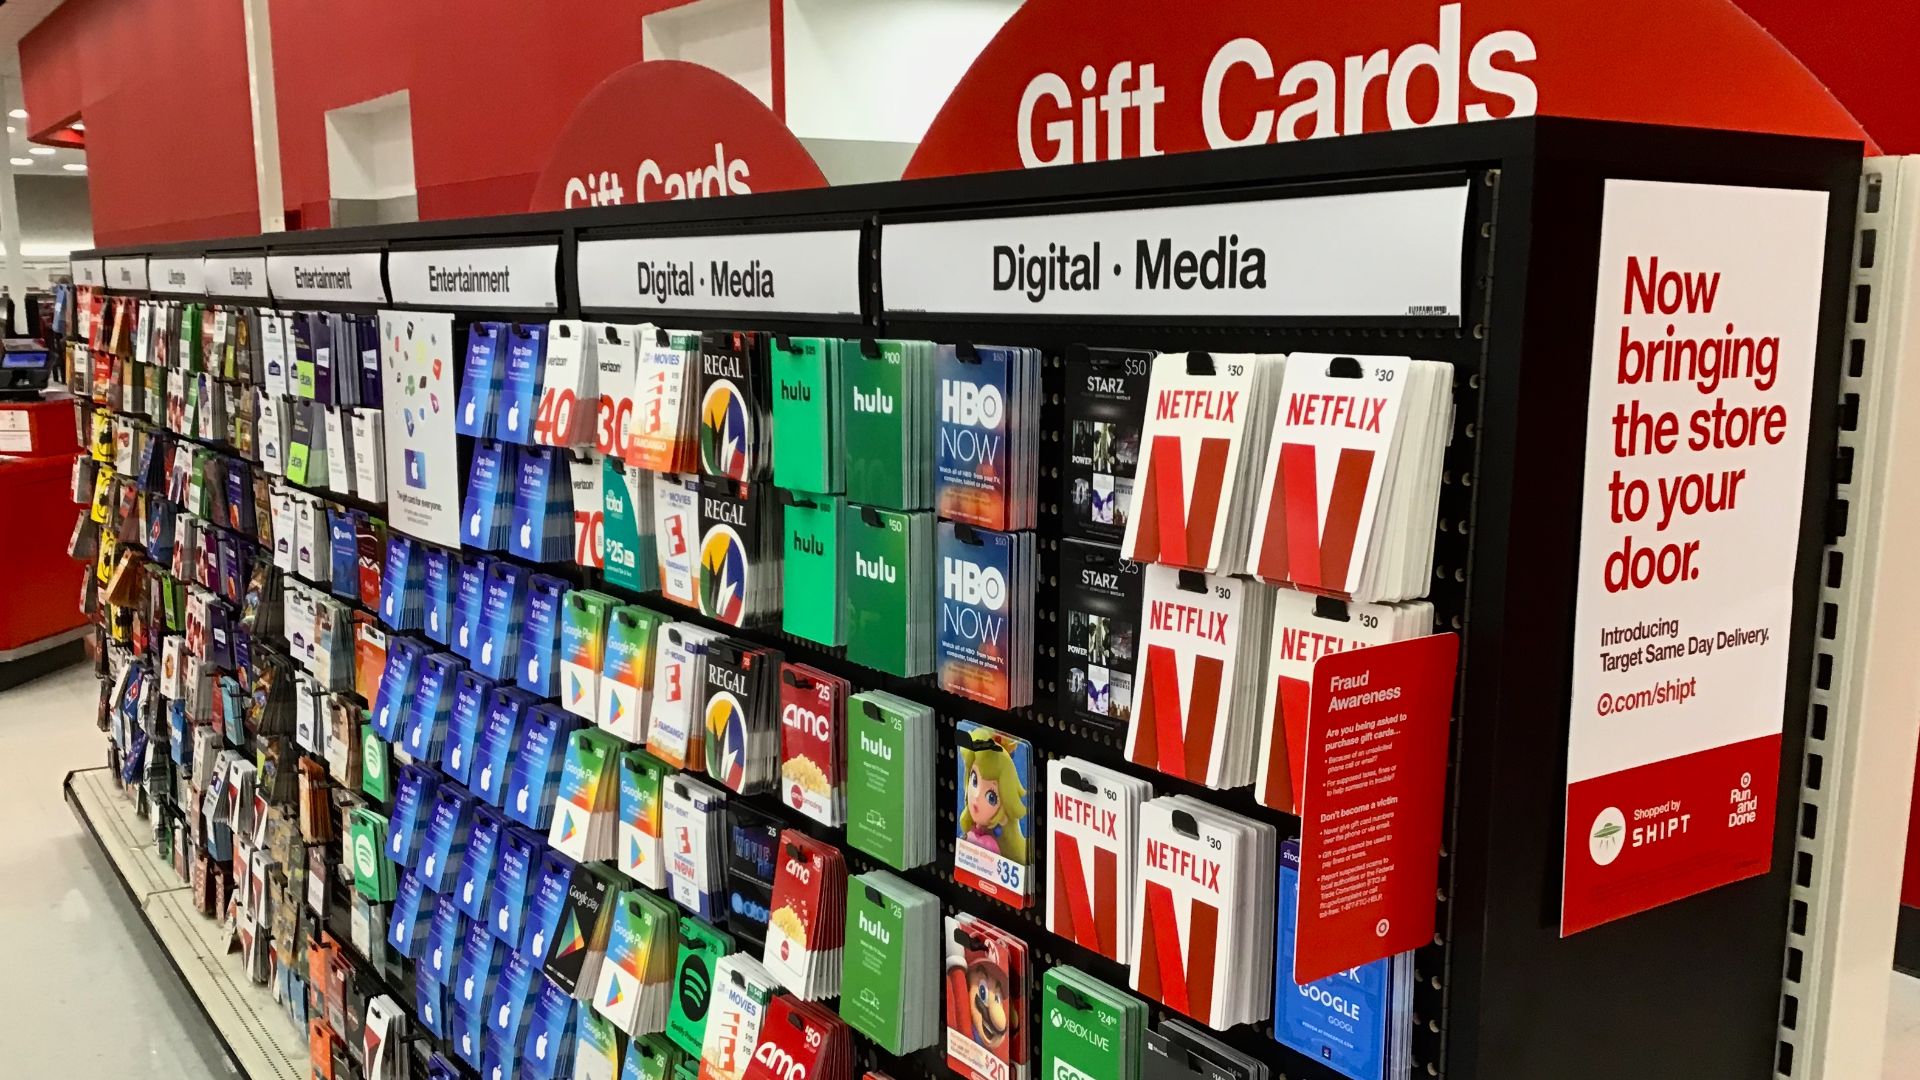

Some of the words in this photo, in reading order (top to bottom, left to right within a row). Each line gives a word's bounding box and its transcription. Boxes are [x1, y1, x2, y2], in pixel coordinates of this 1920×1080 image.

[1017, 61, 1165, 169] Gift
[1201, 2, 1538, 151] Cards
[565, 171, 624, 209] Gift
[637, 142, 752, 204] Cards
[294, 265, 352, 290] Entertainment
[428, 265, 511, 293] Entertainment
[992, 242, 1101, 303] Digital
[1135, 233, 1268, 291] Media
[637, 261, 695, 304] Digital
[710, 260, 775, 298] Media
[1624, 256, 1721, 315] Now
[599, 361, 621, 373] verizon
[703, 354, 744, 379] REGAL
[884, 351, 901, 365] $100
[1124, 357, 1147, 377] $50
[1226, 364, 1244, 378] $30
[1617, 322, 1780, 395] bringing
[1087, 375, 1125, 395] STARZ
[1375, 368, 1394, 382] $30
[781, 378, 811, 402] hulu
[853, 386, 893, 414] hulu
[942, 378, 1003, 430] HBO
[1156, 389, 1240, 424] NETFLIX
[1286, 392, 1388, 434] NETFLIX
[1612, 400, 1680, 458] the
[1688, 398, 1788, 452] store
[941, 426, 998, 466] NOW
[573, 479, 594, 490] verizon
[704, 497, 747, 526] REGAL
[1608, 470, 1650, 524] to
[1656, 468, 1746, 532] your
[889, 518, 903, 533] $50
[793, 530, 824, 556] hulu
[855, 550, 897, 584] hulu
[1118, 557, 1139, 575] $25
[1603, 535, 1700, 594] door.
[944, 556, 1006, 611] HBO
[1081, 569, 1119, 590] STARZ
[1215, 585, 1231, 599] $30
[943, 602, 1002, 647] NOW
[1149, 599, 1229, 646] NETFLIX
[1359, 612, 1378, 629] $30
[1600, 617, 1679, 649] Introducing
[1600, 648, 1644, 674] Target
[1645, 642, 1685, 666] Same
[1687, 636, 1714, 658] Day
[1716, 626, 1770, 653] Delivery.
[708, 662, 748, 698] REGAL
[815, 682, 831, 702] $25
[1330, 670, 1370, 693] Fraud
[1328, 686, 1402, 713] Awareness
[782, 703, 830, 742] amc
[891, 717, 902, 732] $25
[1325, 728, 1339, 739] Are
[1340, 726, 1354, 737] you
[1355, 720, 1375, 732] being
[1376, 714, 1398, 726] asked
[1399, 713, 1407, 721] to
[860, 730, 892, 761] hulu
[1325, 737, 1359, 752] purchase
[1360, 733, 1373, 745] gift
[1329, 753, 1350, 764] Because
[1366, 742, 1392, 754] unsolicited
[1328, 764, 1344, 774] phone
[1104, 787, 1117, 801] $60
[1730, 788, 1751, 804] Run
[1737, 795, 1758, 815] and
[1054, 791, 1117, 841] NETFLIX
[1320, 811, 1339, 823] Don't
[1340, 805, 1369, 817] become
[1376, 796, 1398, 806] victim
[1633, 800, 1670, 822] Shopped
[1671, 799, 1681, 813] by
[1728, 812, 1757, 828] Done
[1206, 835, 1222, 850] $30
[1632, 813, 1691, 849] SHIPT
[785, 858, 810, 885] amc
[996, 859, 1020, 889] $35
[1146, 837, 1221, 894] NETFLIX
[569, 884, 586, 906] Google
[890, 902, 903, 919] $25
[859, 910, 890, 945] hulu
[728, 989, 757, 1017] MOVIES
[1298, 984, 1361, 1021] GOOGLE
[804, 1024, 821, 1048] $50
[1062, 1016, 1089, 1041] XBOX
[1088, 1034, 1110, 1053] LIVE
[1327, 1015, 1355, 1034] GOOGL
